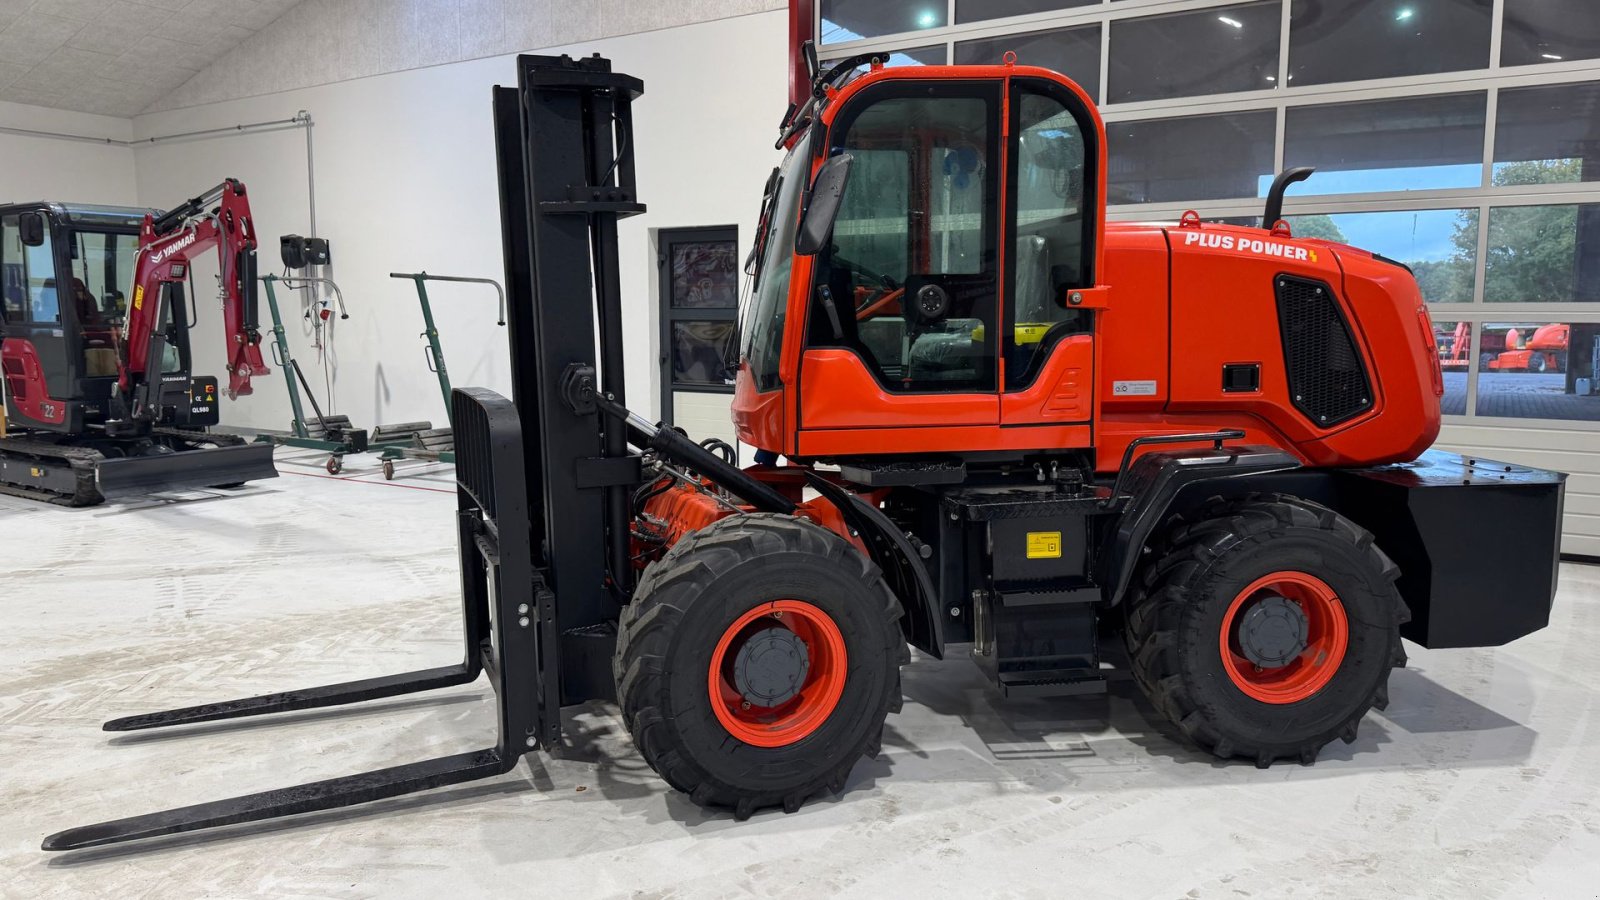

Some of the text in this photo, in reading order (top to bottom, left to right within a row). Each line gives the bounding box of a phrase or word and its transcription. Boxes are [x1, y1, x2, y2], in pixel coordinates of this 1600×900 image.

[163, 233, 195, 257] YANMAR
[1185, 232, 1308, 260] PLUS POWER
